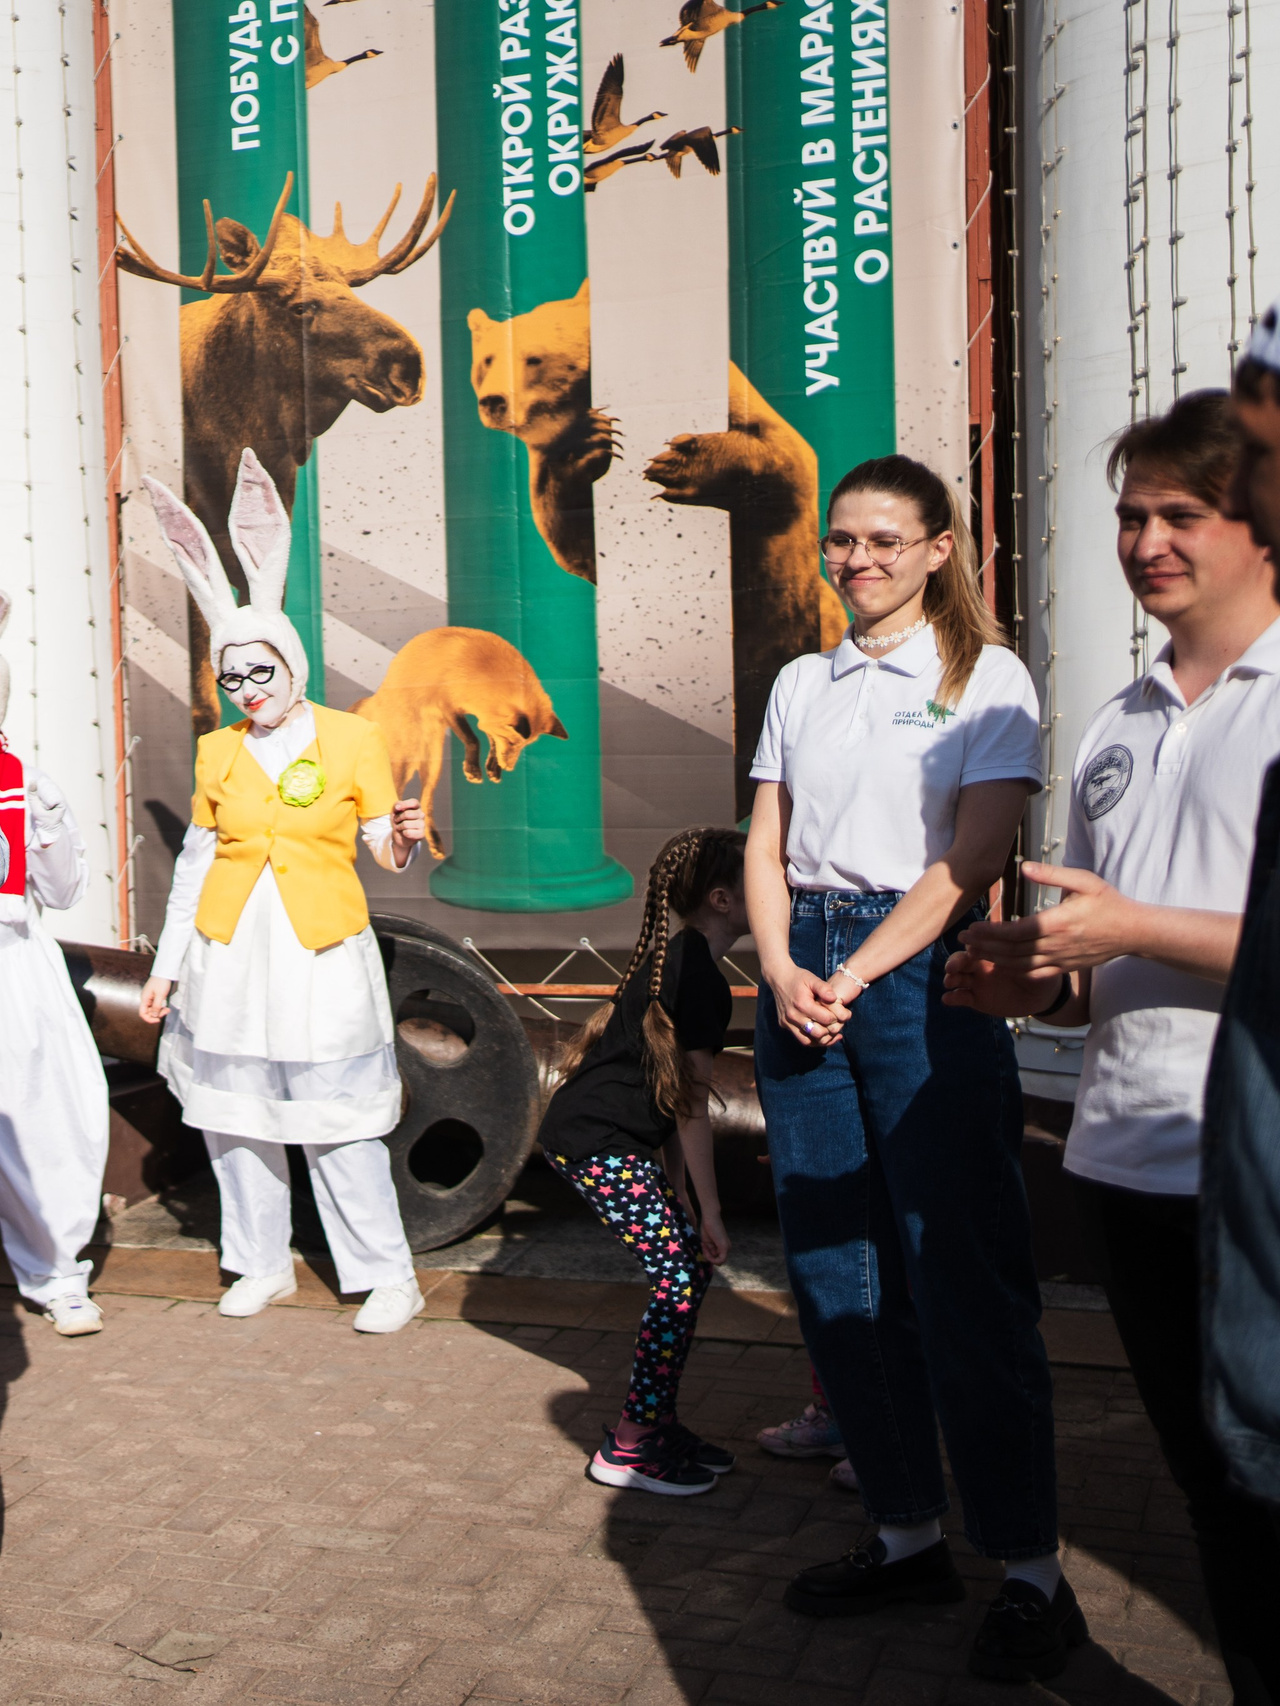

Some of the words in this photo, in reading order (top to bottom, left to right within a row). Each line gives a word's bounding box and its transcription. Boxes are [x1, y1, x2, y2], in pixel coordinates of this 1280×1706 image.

[270, 34, 300, 65] С
[228, 0, 262, 151] ПОБУДЬ
[492, 73, 536, 236] ОТКРОЙ
[802, 138, 836, 165] В
[853, 248, 889, 284] О
[793, 177, 840, 396] УЧАСТВУЙ
[891, 718, 934, 729] ПРИРОДЫ
[894, 711, 923, 719] ОТДЕЛ
